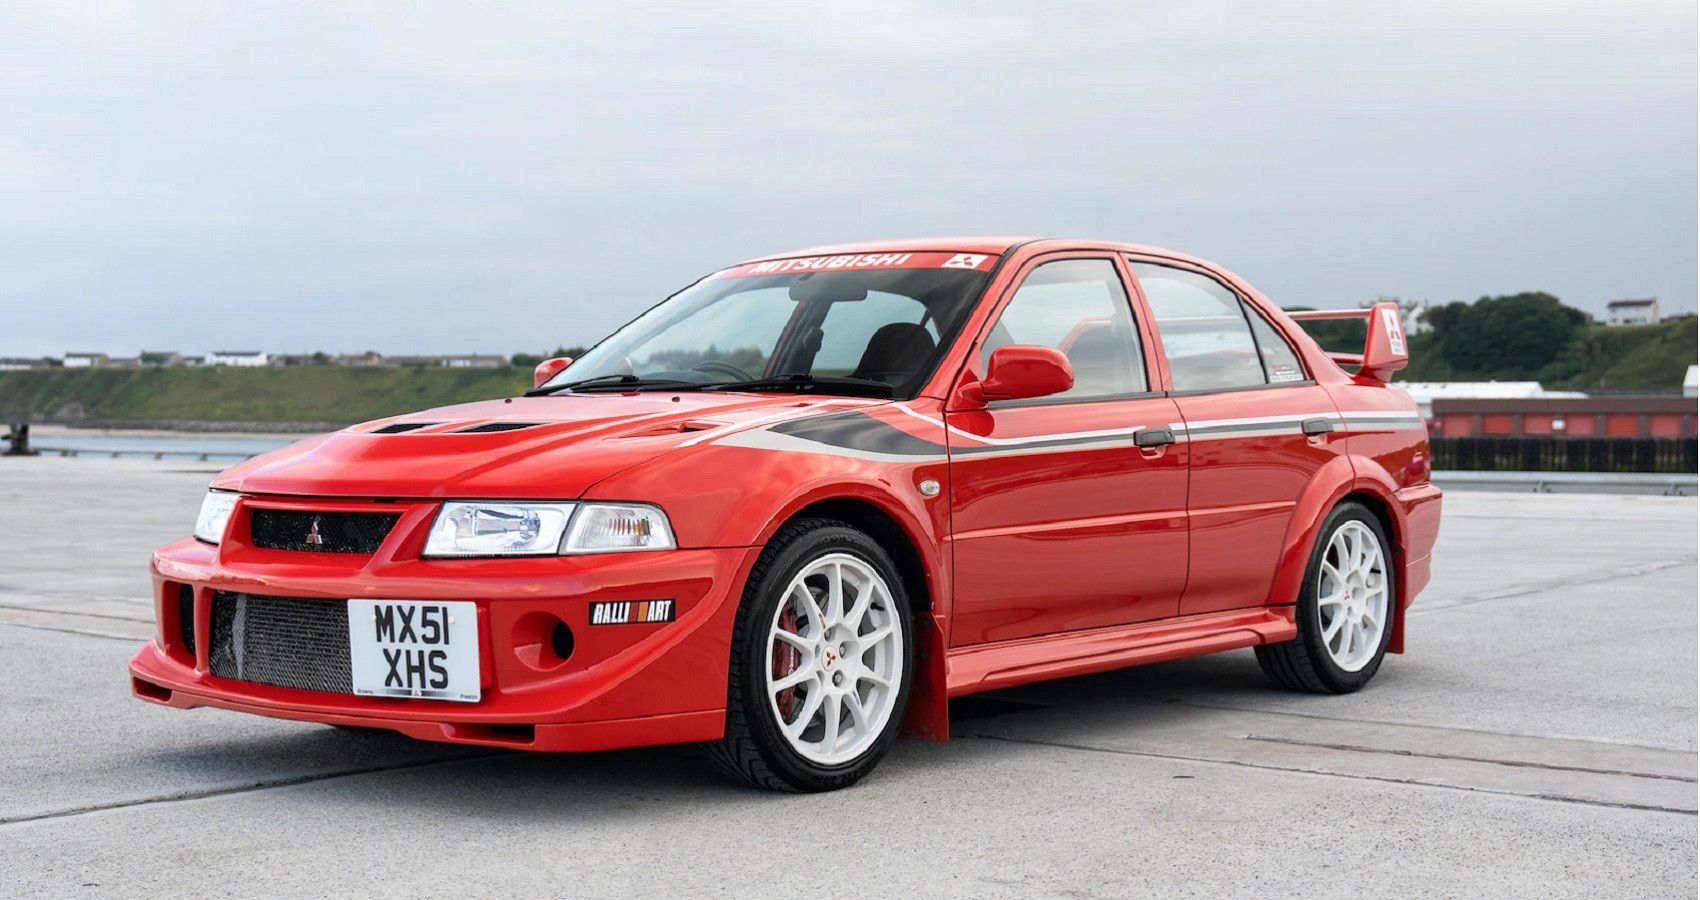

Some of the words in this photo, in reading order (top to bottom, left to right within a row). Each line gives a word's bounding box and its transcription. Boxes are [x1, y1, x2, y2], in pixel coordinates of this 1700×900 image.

[749, 253, 912, 273] MITSUBISHI
[374, 605, 450, 645] MX51
[382, 648, 449, 690] XHS
